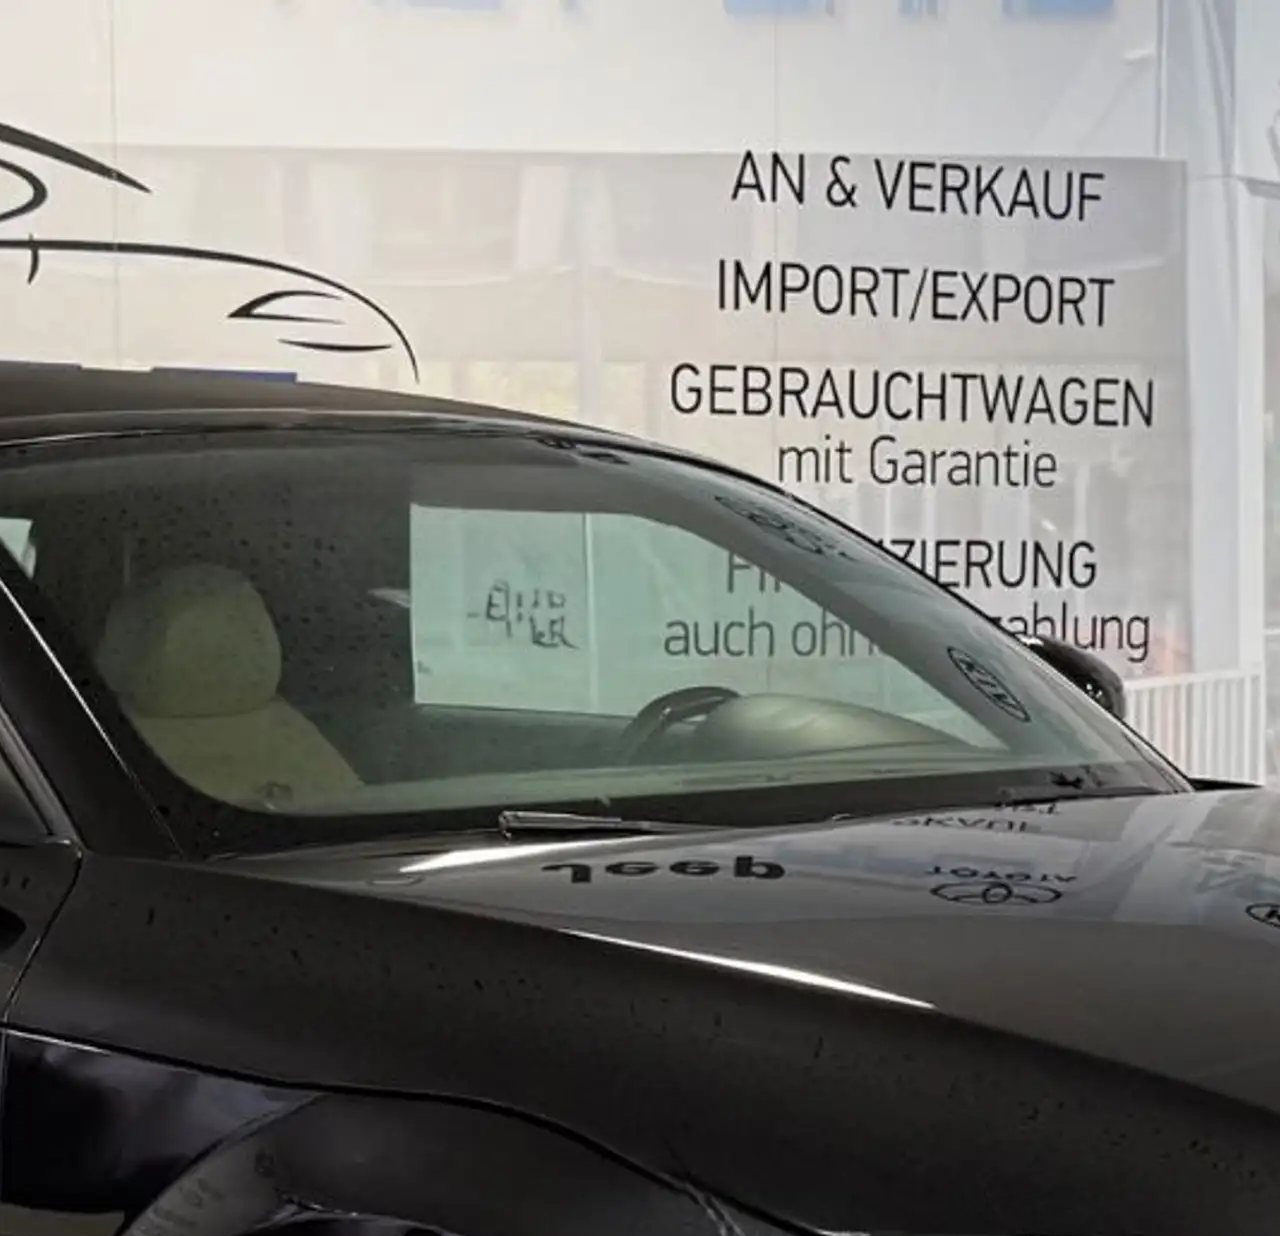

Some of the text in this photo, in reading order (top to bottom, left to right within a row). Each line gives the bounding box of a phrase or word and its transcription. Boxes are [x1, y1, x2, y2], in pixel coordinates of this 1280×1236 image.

[731, 150, 1105, 222] AN & VERKAUF
[718, 259, 1115, 327] IMPORT/EXPORT
[670, 363, 1154, 428] GEBRAUCHTWAGEN
[777, 434, 1058, 488] mit Garantie
[664, 607, 775, 657] auch
